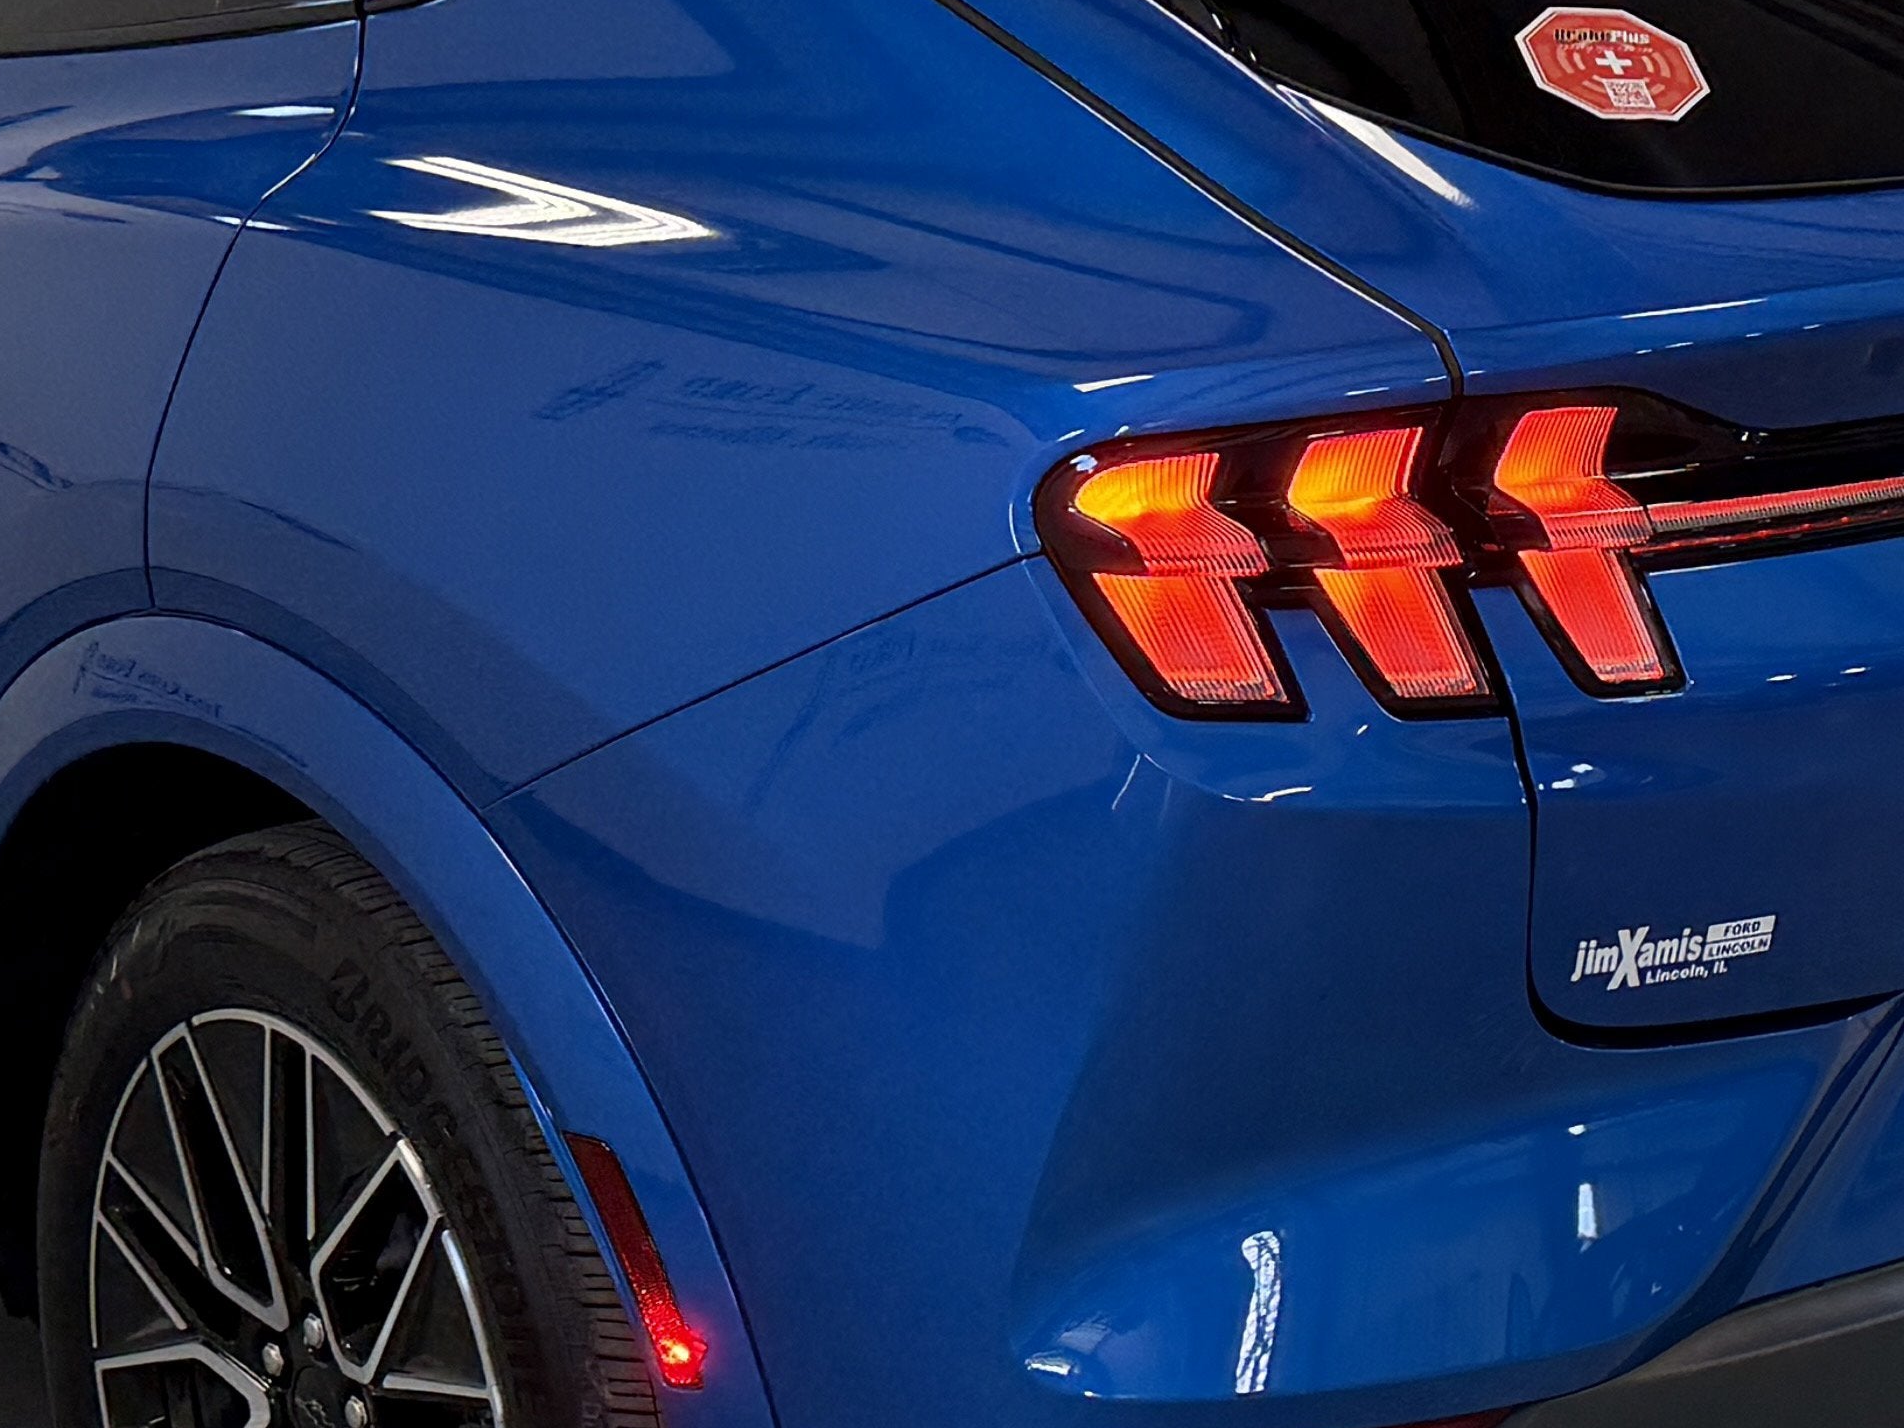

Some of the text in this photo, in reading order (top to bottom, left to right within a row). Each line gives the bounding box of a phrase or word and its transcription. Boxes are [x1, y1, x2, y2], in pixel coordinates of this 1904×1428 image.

[1723, 920, 1761, 938] FORD
[1707, 936, 1769, 959] LINCOLN
[1645, 963, 1709, 985] Lincoln,
